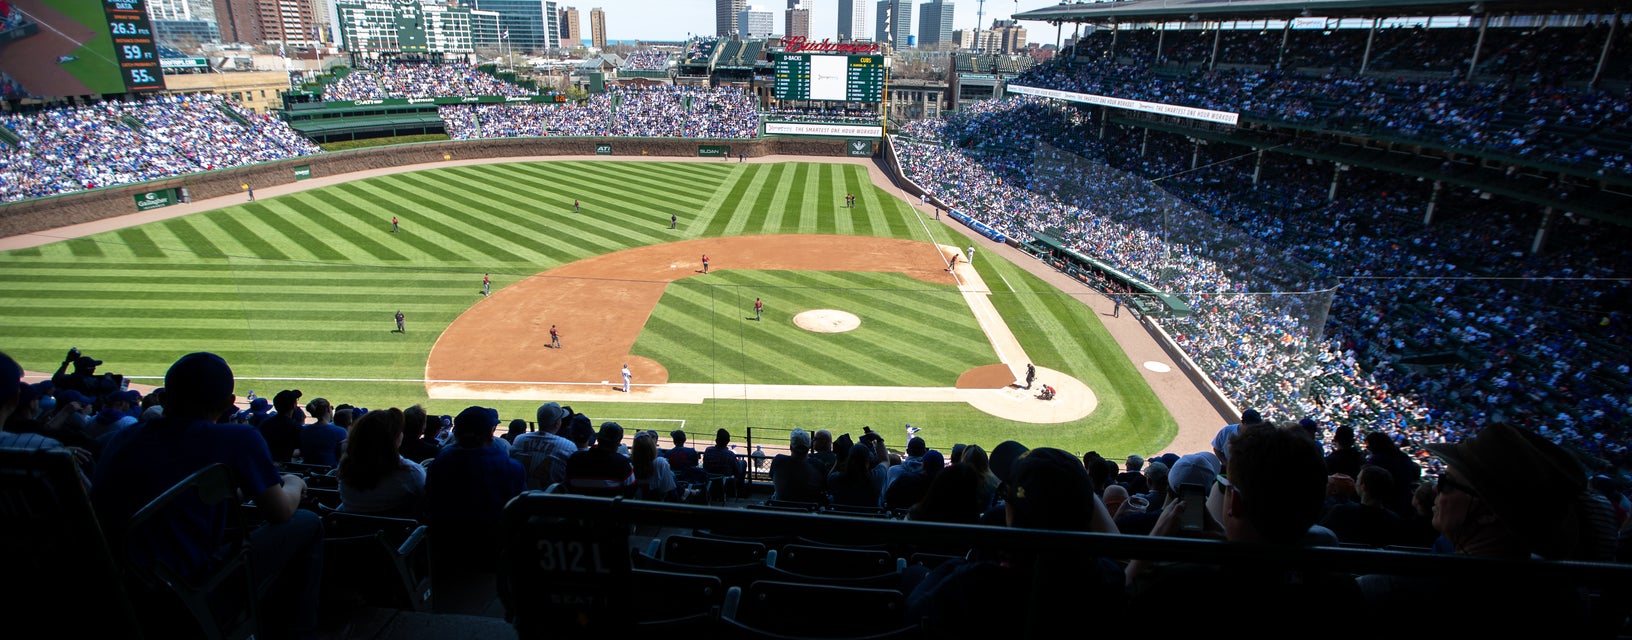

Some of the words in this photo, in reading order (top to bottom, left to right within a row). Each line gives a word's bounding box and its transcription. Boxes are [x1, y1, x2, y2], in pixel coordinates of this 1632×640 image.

[110, 22, 137, 35] 26.3
[122, 45, 142, 59] 59
[780, 35, 880, 53] Budweiser
[1155, 104, 1164, 112] THE
[1164, 106, 1187, 114] SMARTEST
[1211, 113, 1236, 121] WORKOUT
[536, 538, 587, 572] 312
[591, 541, 611, 575] L
